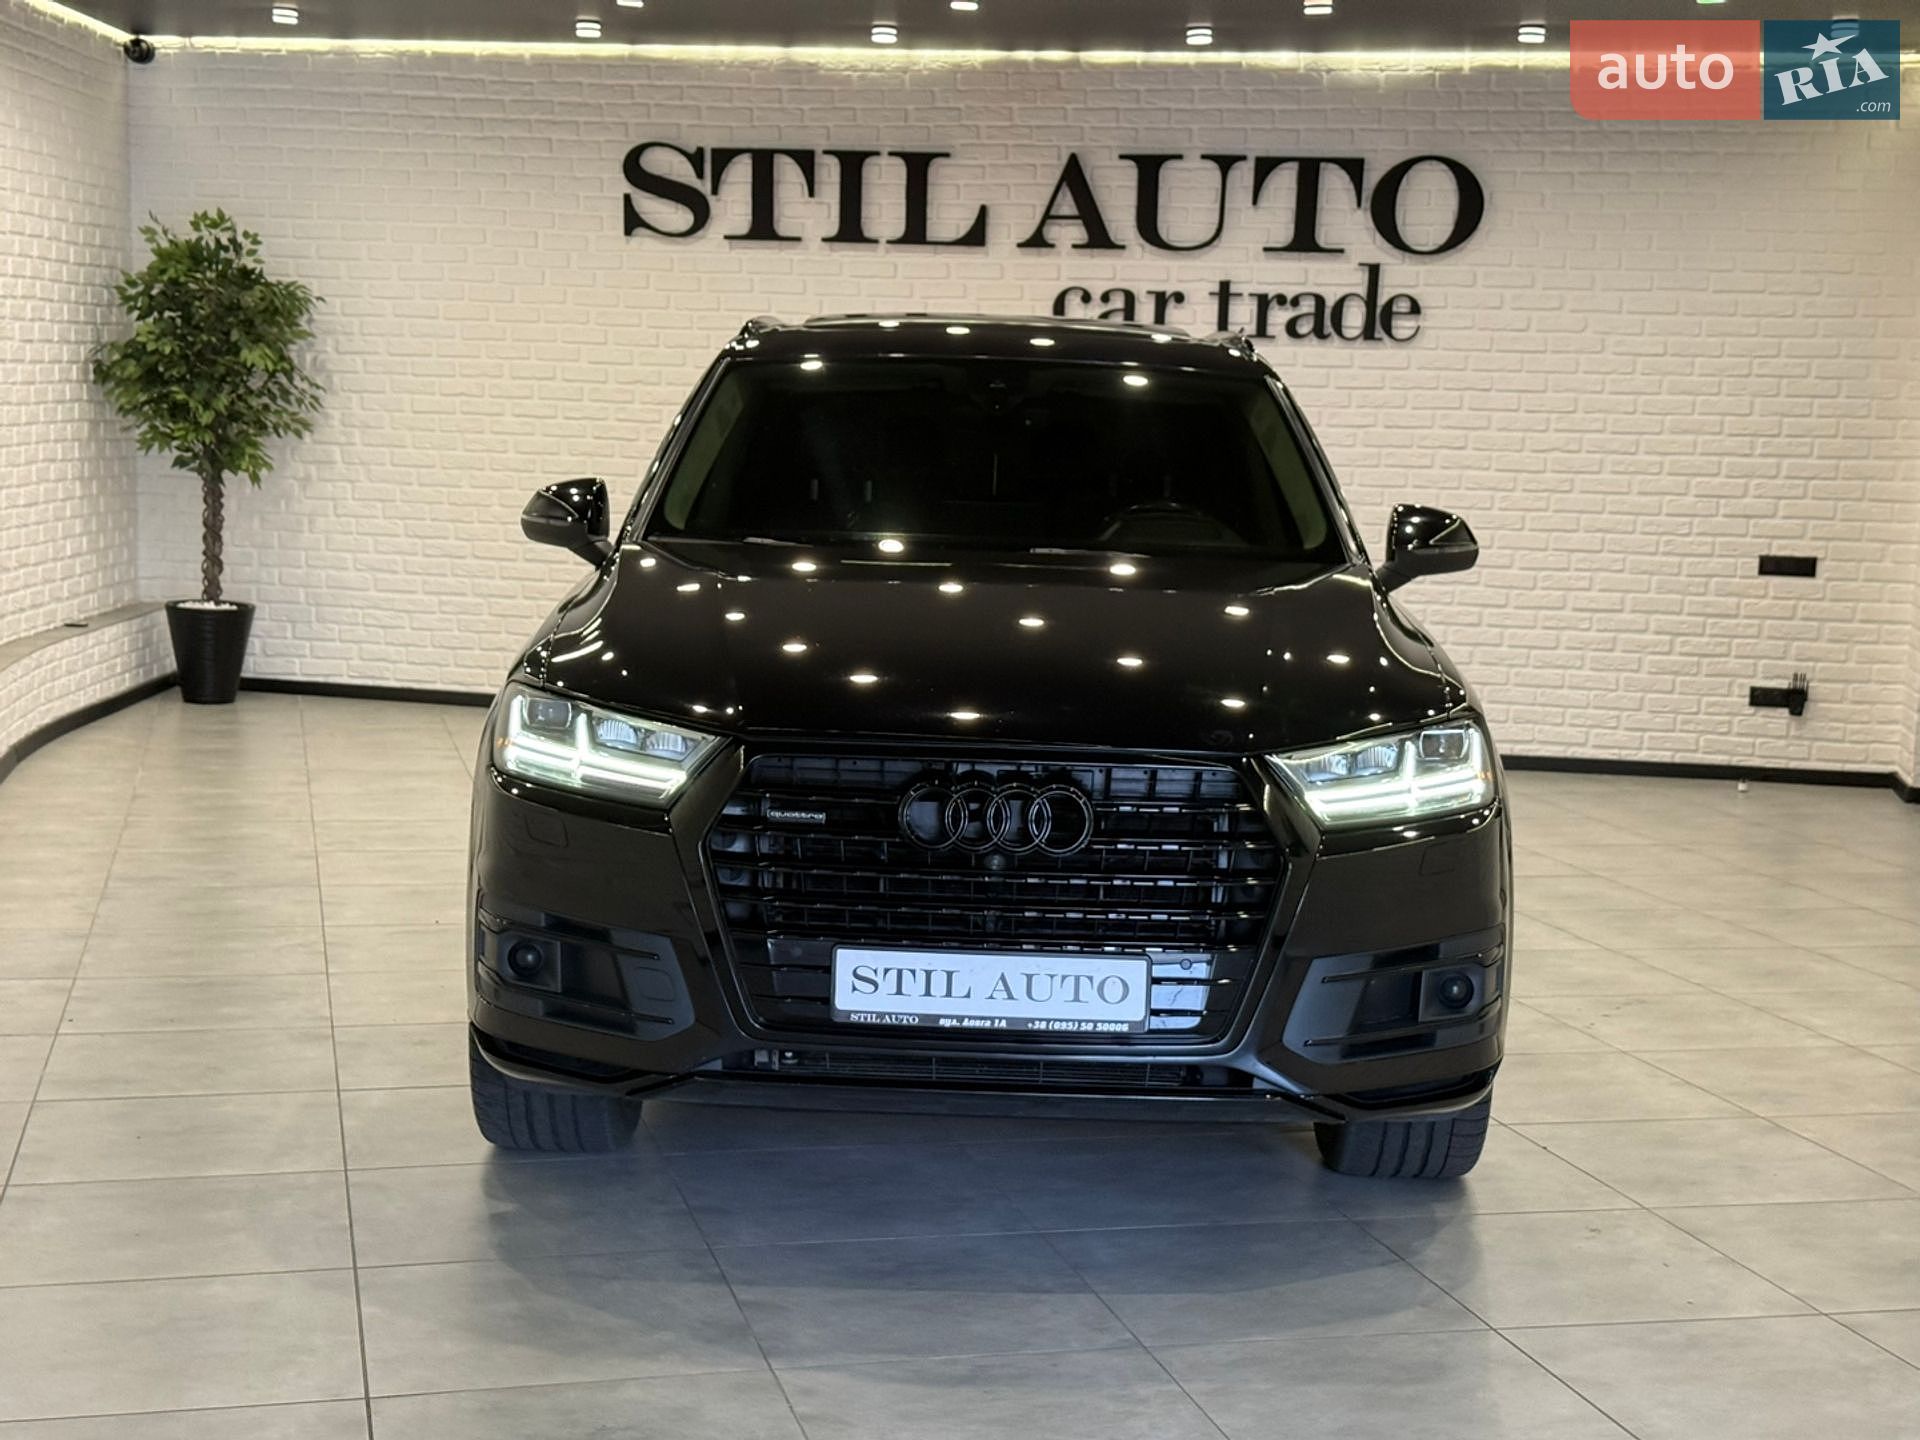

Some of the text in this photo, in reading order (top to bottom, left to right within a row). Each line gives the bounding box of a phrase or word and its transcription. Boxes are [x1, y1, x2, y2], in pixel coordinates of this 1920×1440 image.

[622, 141, 1485, 255] STIL AUTO
[1208, 262, 1422, 342] trade
[770, 811, 824, 820] quattro
[850, 965, 1130, 1005] STIL AUTO
[850, 1012, 919, 1025] STIL AUTO
